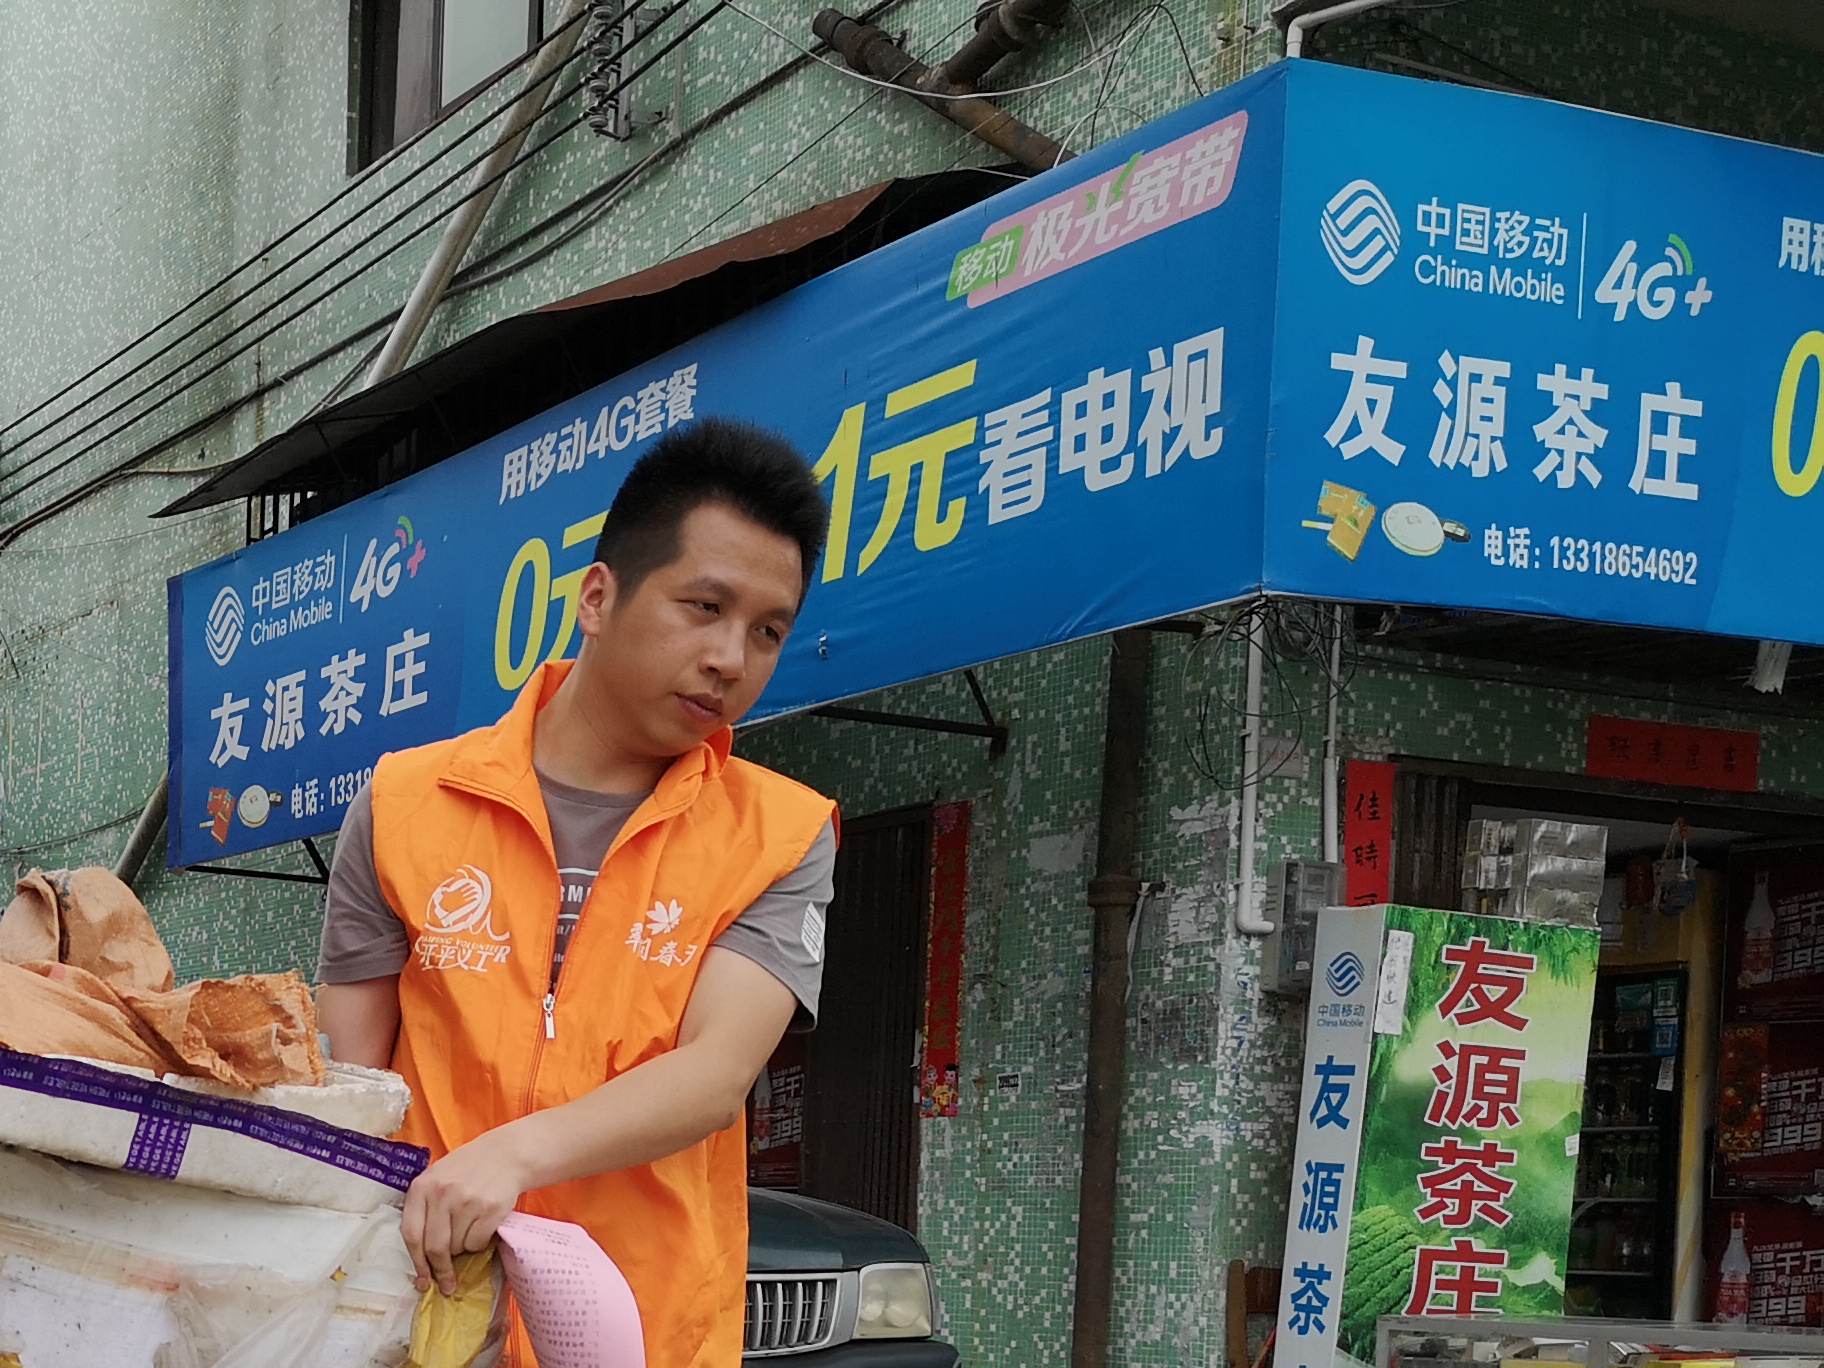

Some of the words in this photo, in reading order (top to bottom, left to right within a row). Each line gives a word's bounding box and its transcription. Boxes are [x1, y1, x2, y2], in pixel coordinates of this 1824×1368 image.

[954, 234, 1014, 294] 移动
[1022, 126, 1241, 277] 极光宽带
[1416, 197, 1569, 267] 中国移动
[1414, 255, 1483, 294] China
[1489, 264, 1565, 305] Mobile
[499, 363, 698, 505] 用移动4G套餐
[1324, 334, 1704, 501] 友源茶庄
[252, 549, 336, 615] 中国移动
[251, 617, 287, 646] China
[289, 596, 333, 633] Mobile
[209, 628, 430, 768] 友源茶庄
[419, 944, 494, 972] 开平义工
[1318, 1003, 1366, 1017] 中国移动
[1405, 938, 1537, 1316] 友源茶庄
